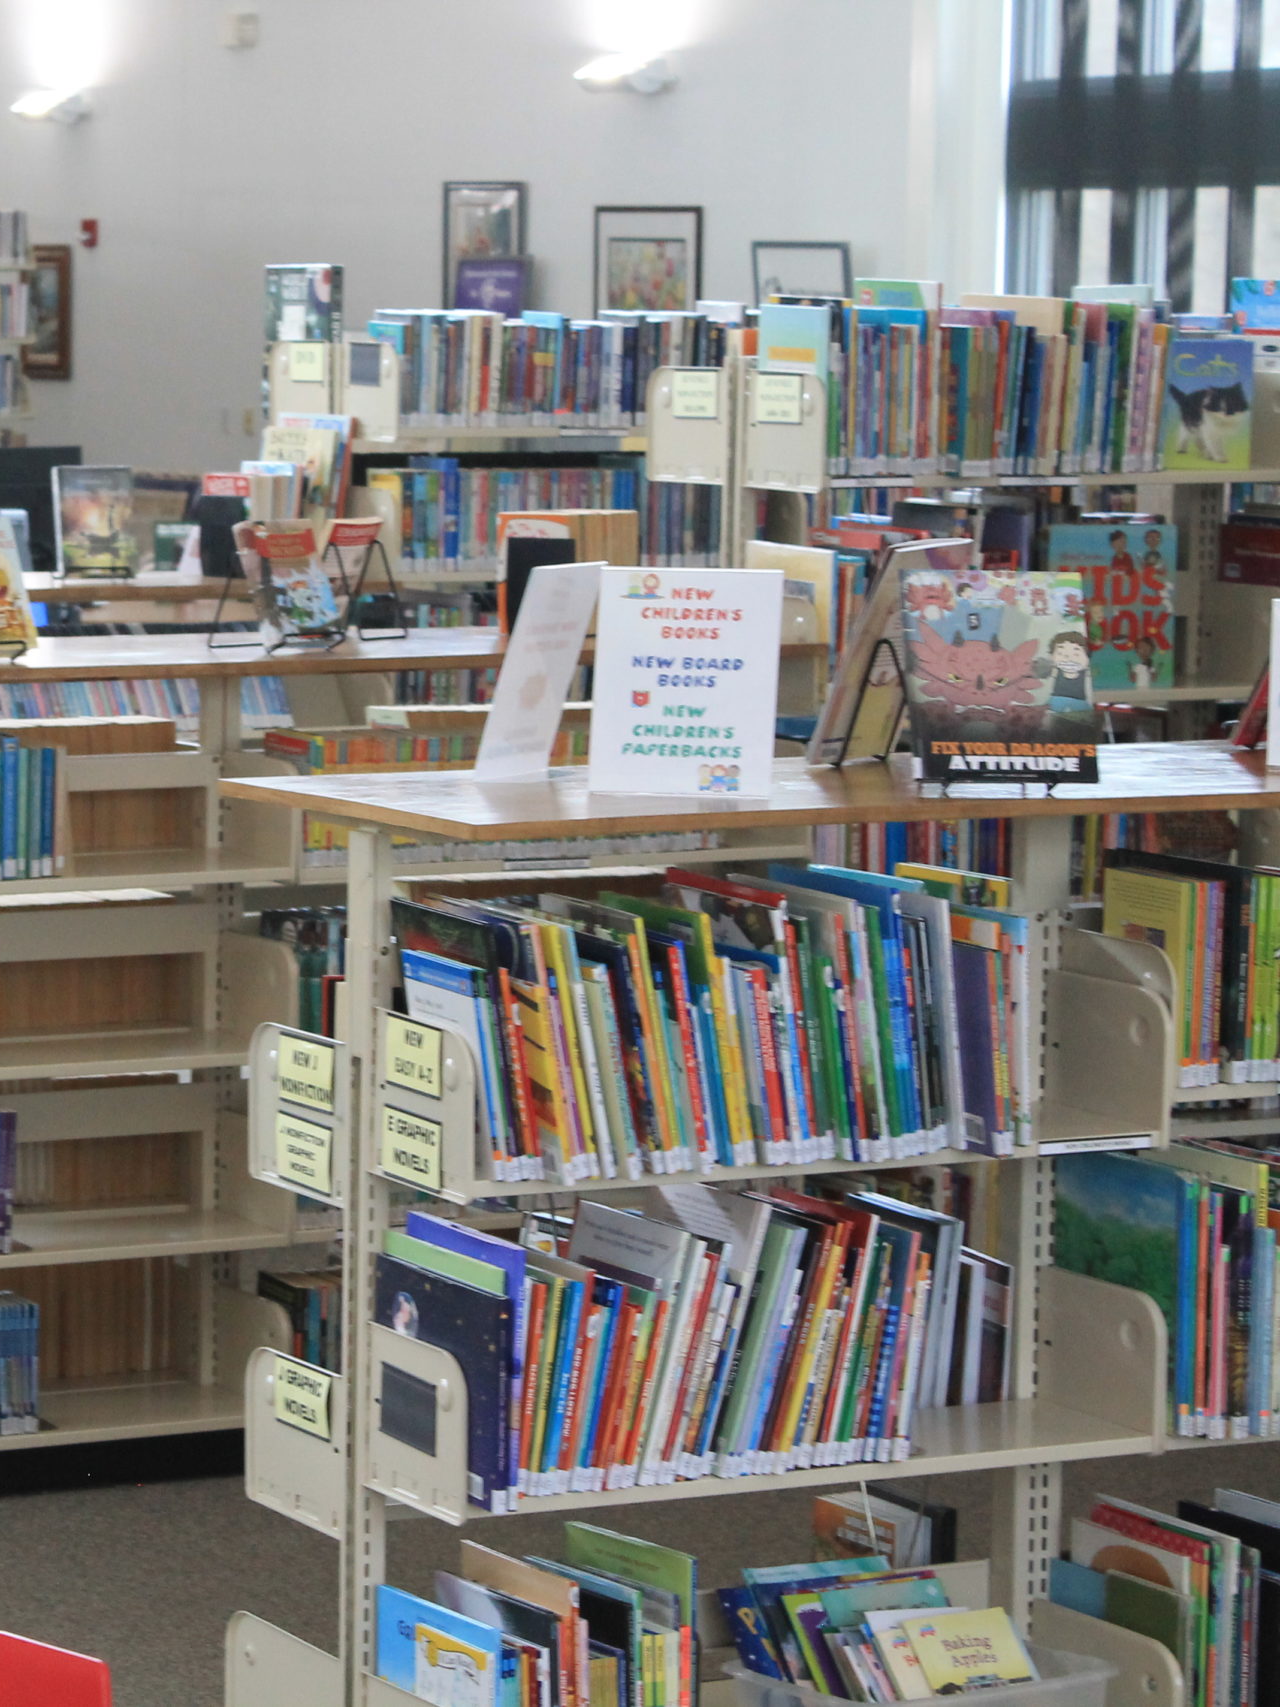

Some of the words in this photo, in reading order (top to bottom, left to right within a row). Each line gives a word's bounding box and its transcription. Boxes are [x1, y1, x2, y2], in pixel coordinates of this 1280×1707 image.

[1058, 564, 1166, 606] IDS
[671, 588, 714, 600] NEW
[661, 625, 720, 639] BOOKS
[631, 656, 673, 669] NEW
[681, 657, 744, 671] BOARD
[657, 674, 717, 687] BOOKS
[662, 705, 706, 718] NEW
[621, 743, 742, 758] PAPERBACKS
[930, 741, 960, 755] FIX
[961, 742, 1007, 756] YOUR
[1008, 743, 1096, 757] DRAGON'S
[948, 755, 1081, 772] ATTITUDE
[405, 1029, 424, 1048] NEW
[280, 1079, 333, 1105] NONFICTION
[286, 1127, 326, 1148] NONFICTION
[387, 1115, 395, 1132] E
[397, 1119, 437, 1147] GRAPHIC
[286, 1144, 316, 1161] GRAPHIC
[289, 1160, 315, 1177] NOVELS
[389, 1149, 430, 1175] NOVELS
[286, 1368, 323, 1398] GRAPHIC
[285, 1398, 317, 1425] NOVELS
[941, 1634, 992, 1651] Baking
[951, 1653, 998, 1669] Apples
